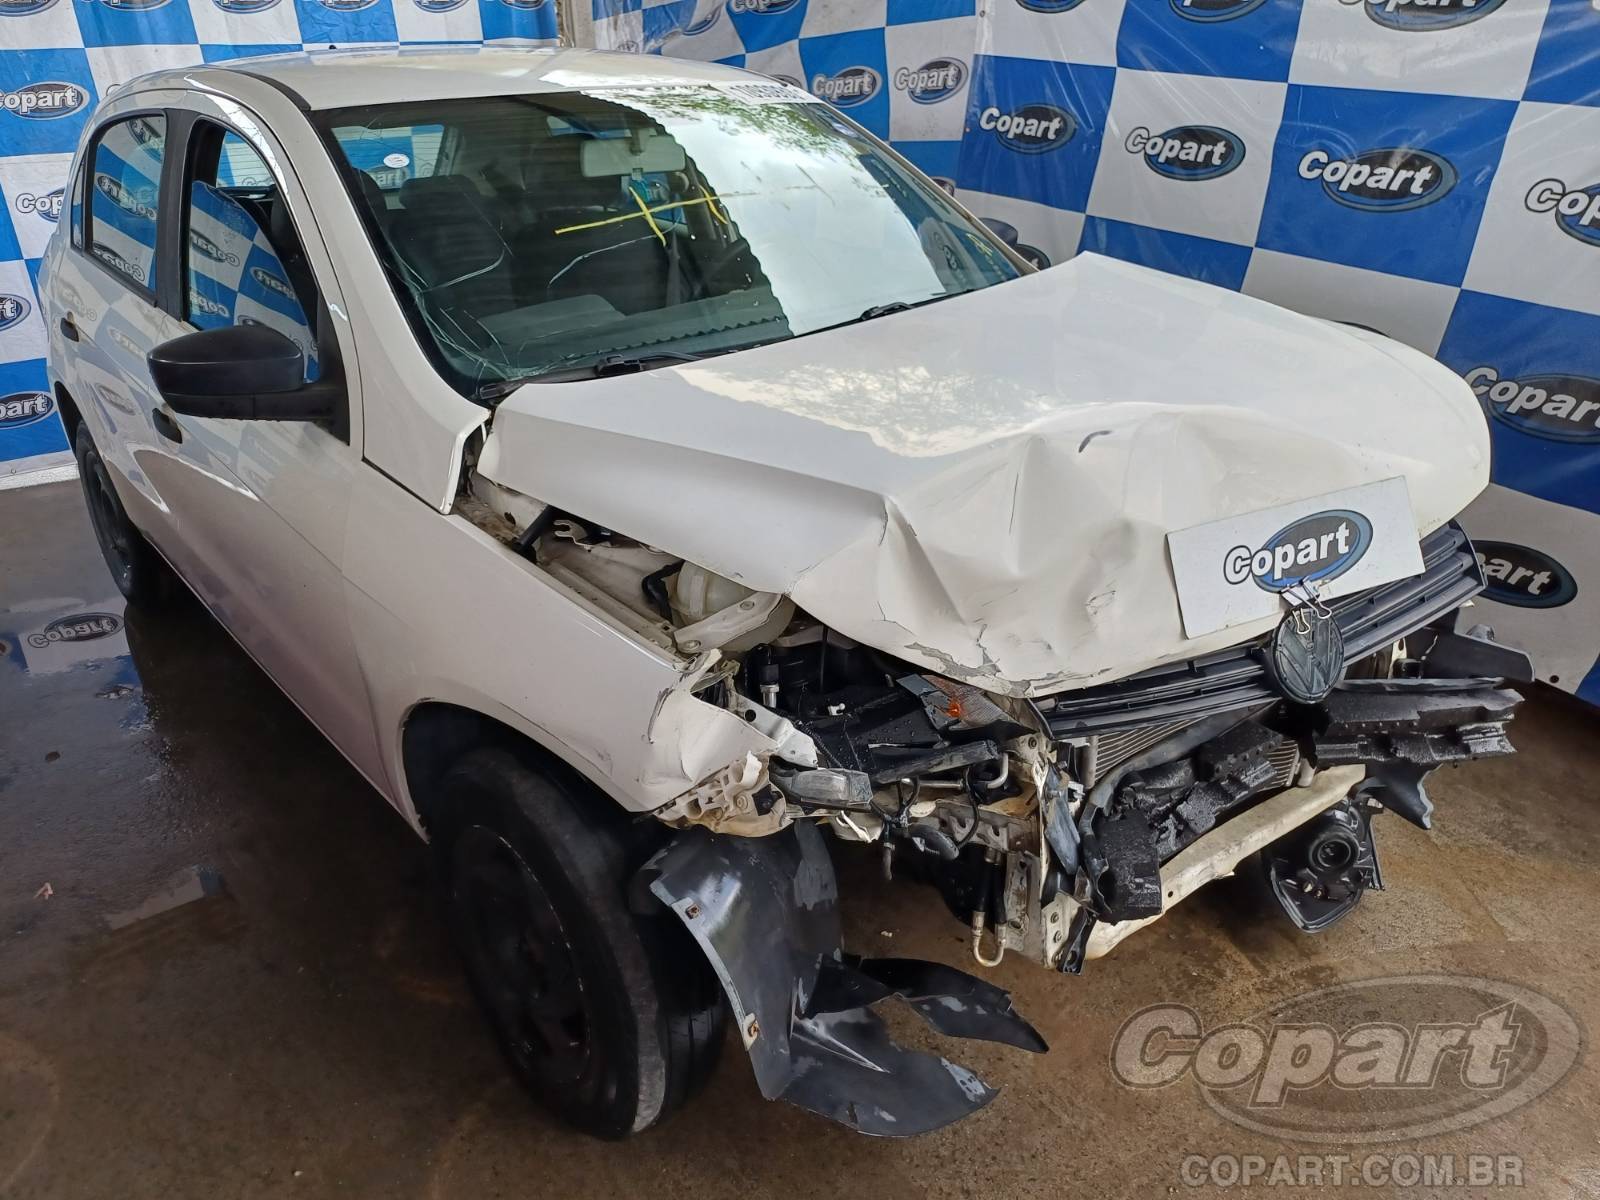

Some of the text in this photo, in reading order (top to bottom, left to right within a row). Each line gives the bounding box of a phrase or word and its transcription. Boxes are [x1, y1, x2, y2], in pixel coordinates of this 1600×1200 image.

[813, 72, 873, 102] Copart
[894, 63, 959, 96] Copart
[0, 86, 78, 114] opart
[979, 106, 1061, 140] Copart
[1125, 126, 1227, 166] Copart
[1298, 150, 1433, 195] Copart
[16, 193, 63, 216] Cop
[1524, 178, 1600, 226] Cop
[0, 394, 47, 420] art
[1463, 366, 1600, 430] Copar
[1223, 521, 1350, 585] Copart
[1477, 552, 1552, 596] art
